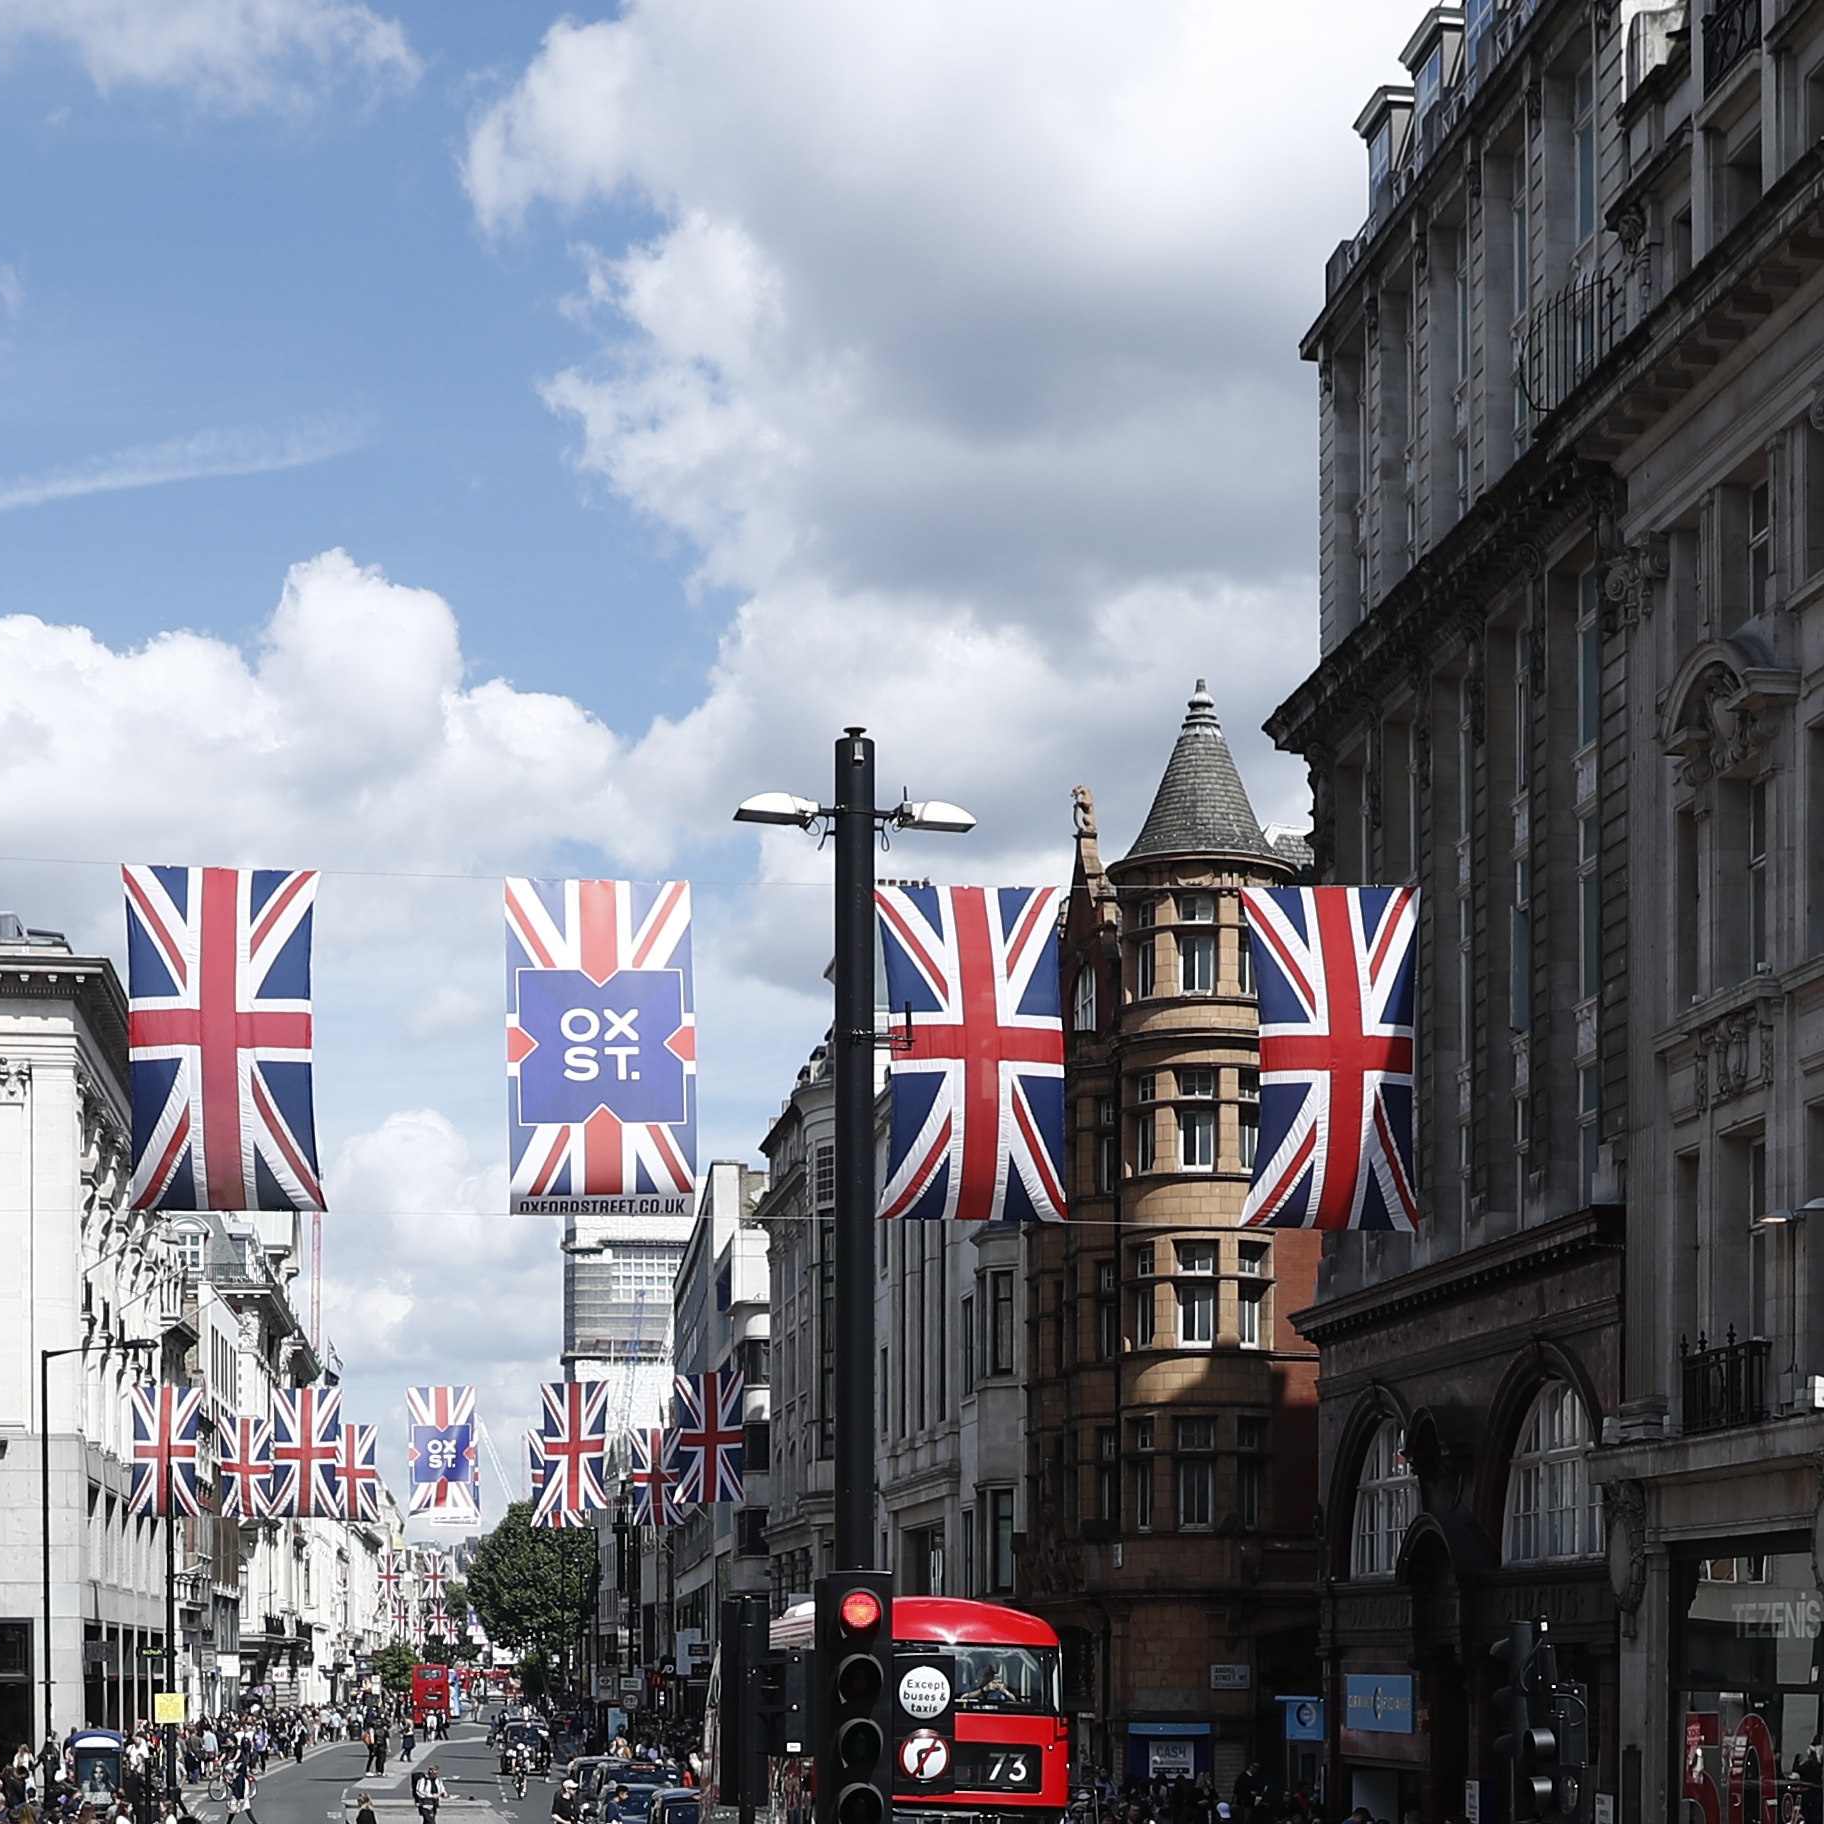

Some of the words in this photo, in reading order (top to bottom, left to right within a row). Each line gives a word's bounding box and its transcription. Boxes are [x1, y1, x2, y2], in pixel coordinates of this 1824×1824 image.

[560, 1008, 640, 1043] OX
[563, 1046, 641, 1081] ST.
[519, 1200, 686, 1216] OXFORDSTREET.CO.UK
[427, 1439, 457, 1454] OX
[428, 1454, 456, 1469] ST.
[906, 1679, 945, 1691] Except
[903, 1691, 936, 1702] buses
[939, 1694, 946, 1702] &
[910, 1703, 938, 1713] taxis
[1156, 1746, 1186, 1759] CASH
[988, 1752, 1027, 1782] 73
